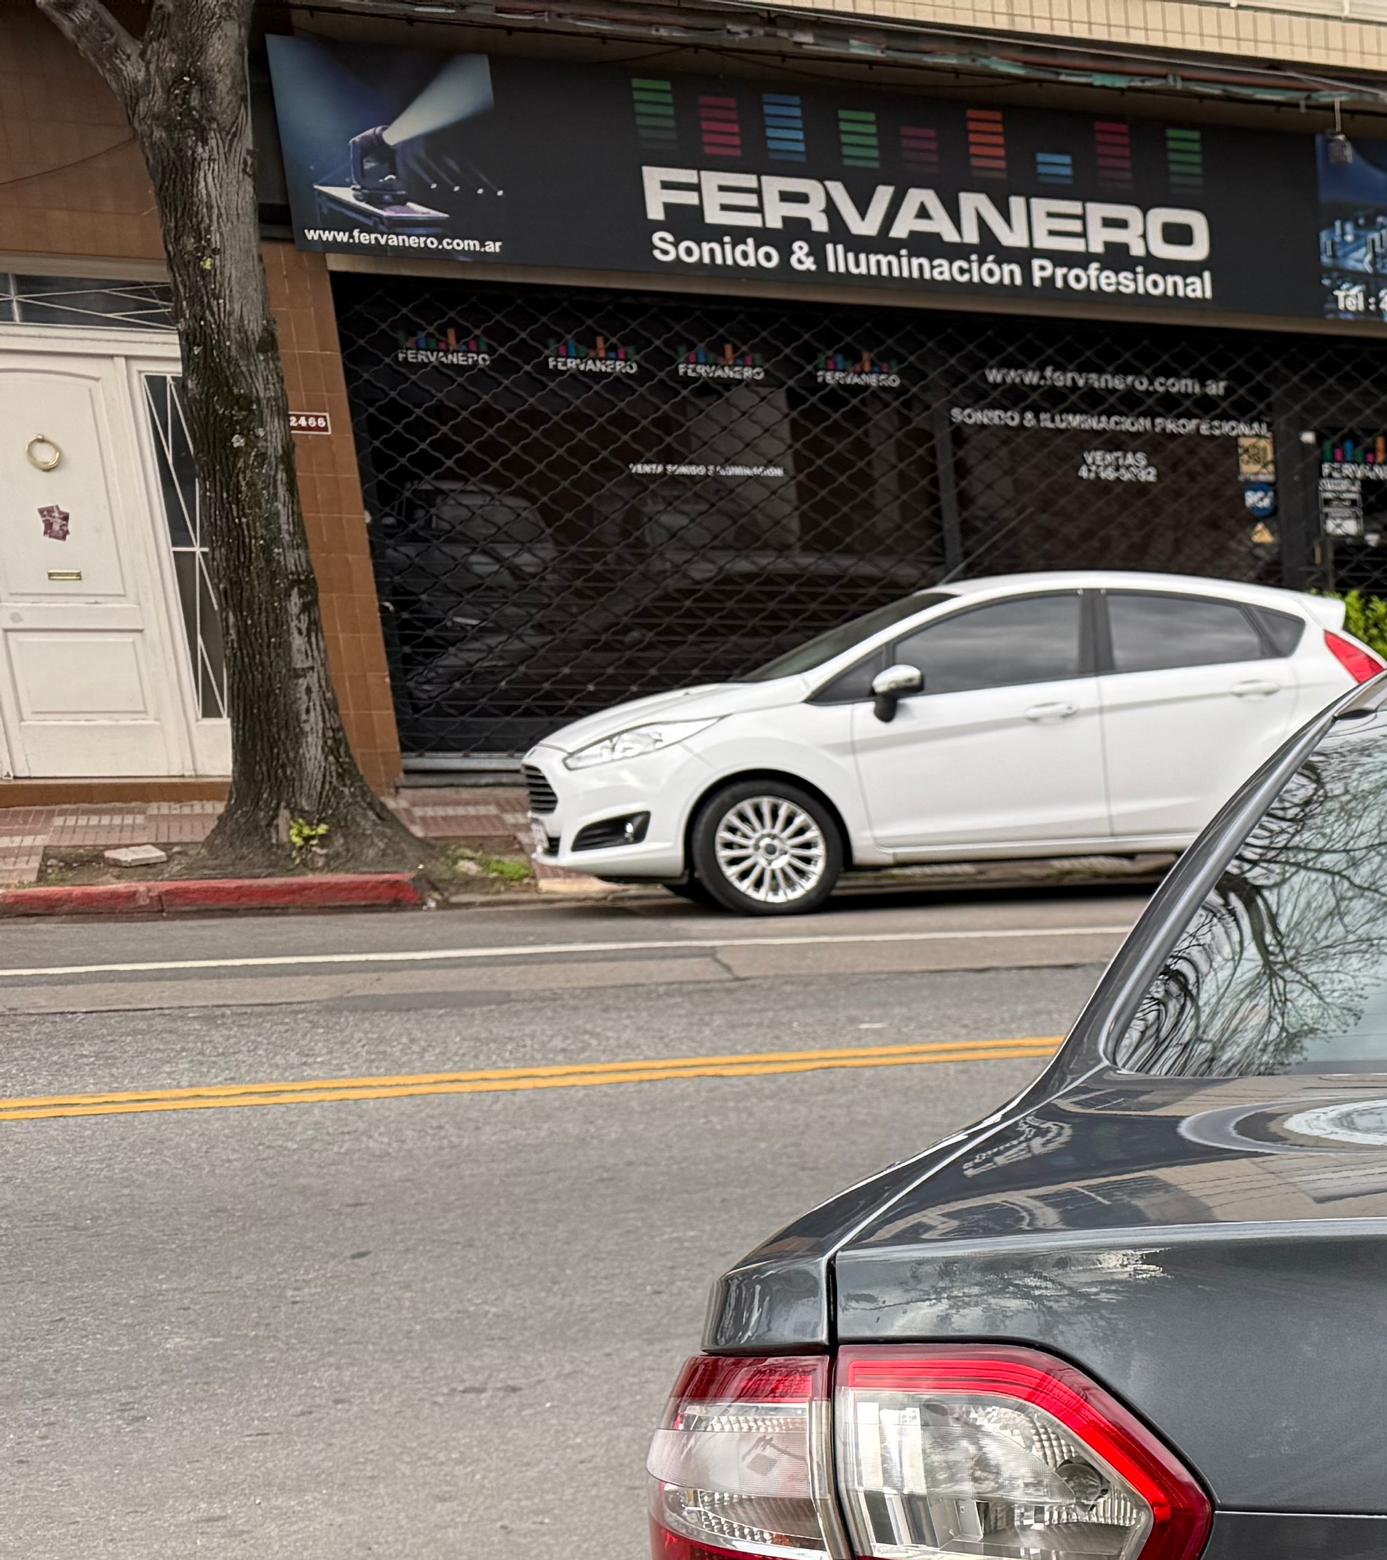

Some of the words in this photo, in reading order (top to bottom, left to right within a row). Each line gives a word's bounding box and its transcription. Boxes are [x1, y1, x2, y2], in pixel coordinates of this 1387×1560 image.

[641, 165, 1210, 262] FERVANERO
[304, 228, 503, 253] www.fervanero.com.ar
[651, 231, 779, 268] Sonido
[789, 240, 816, 272] &
[827, 243, 1022, 286] Iluminación
[1031, 257, 1213, 299] Profesional
[1333, 289, 1365, 312] Tel
